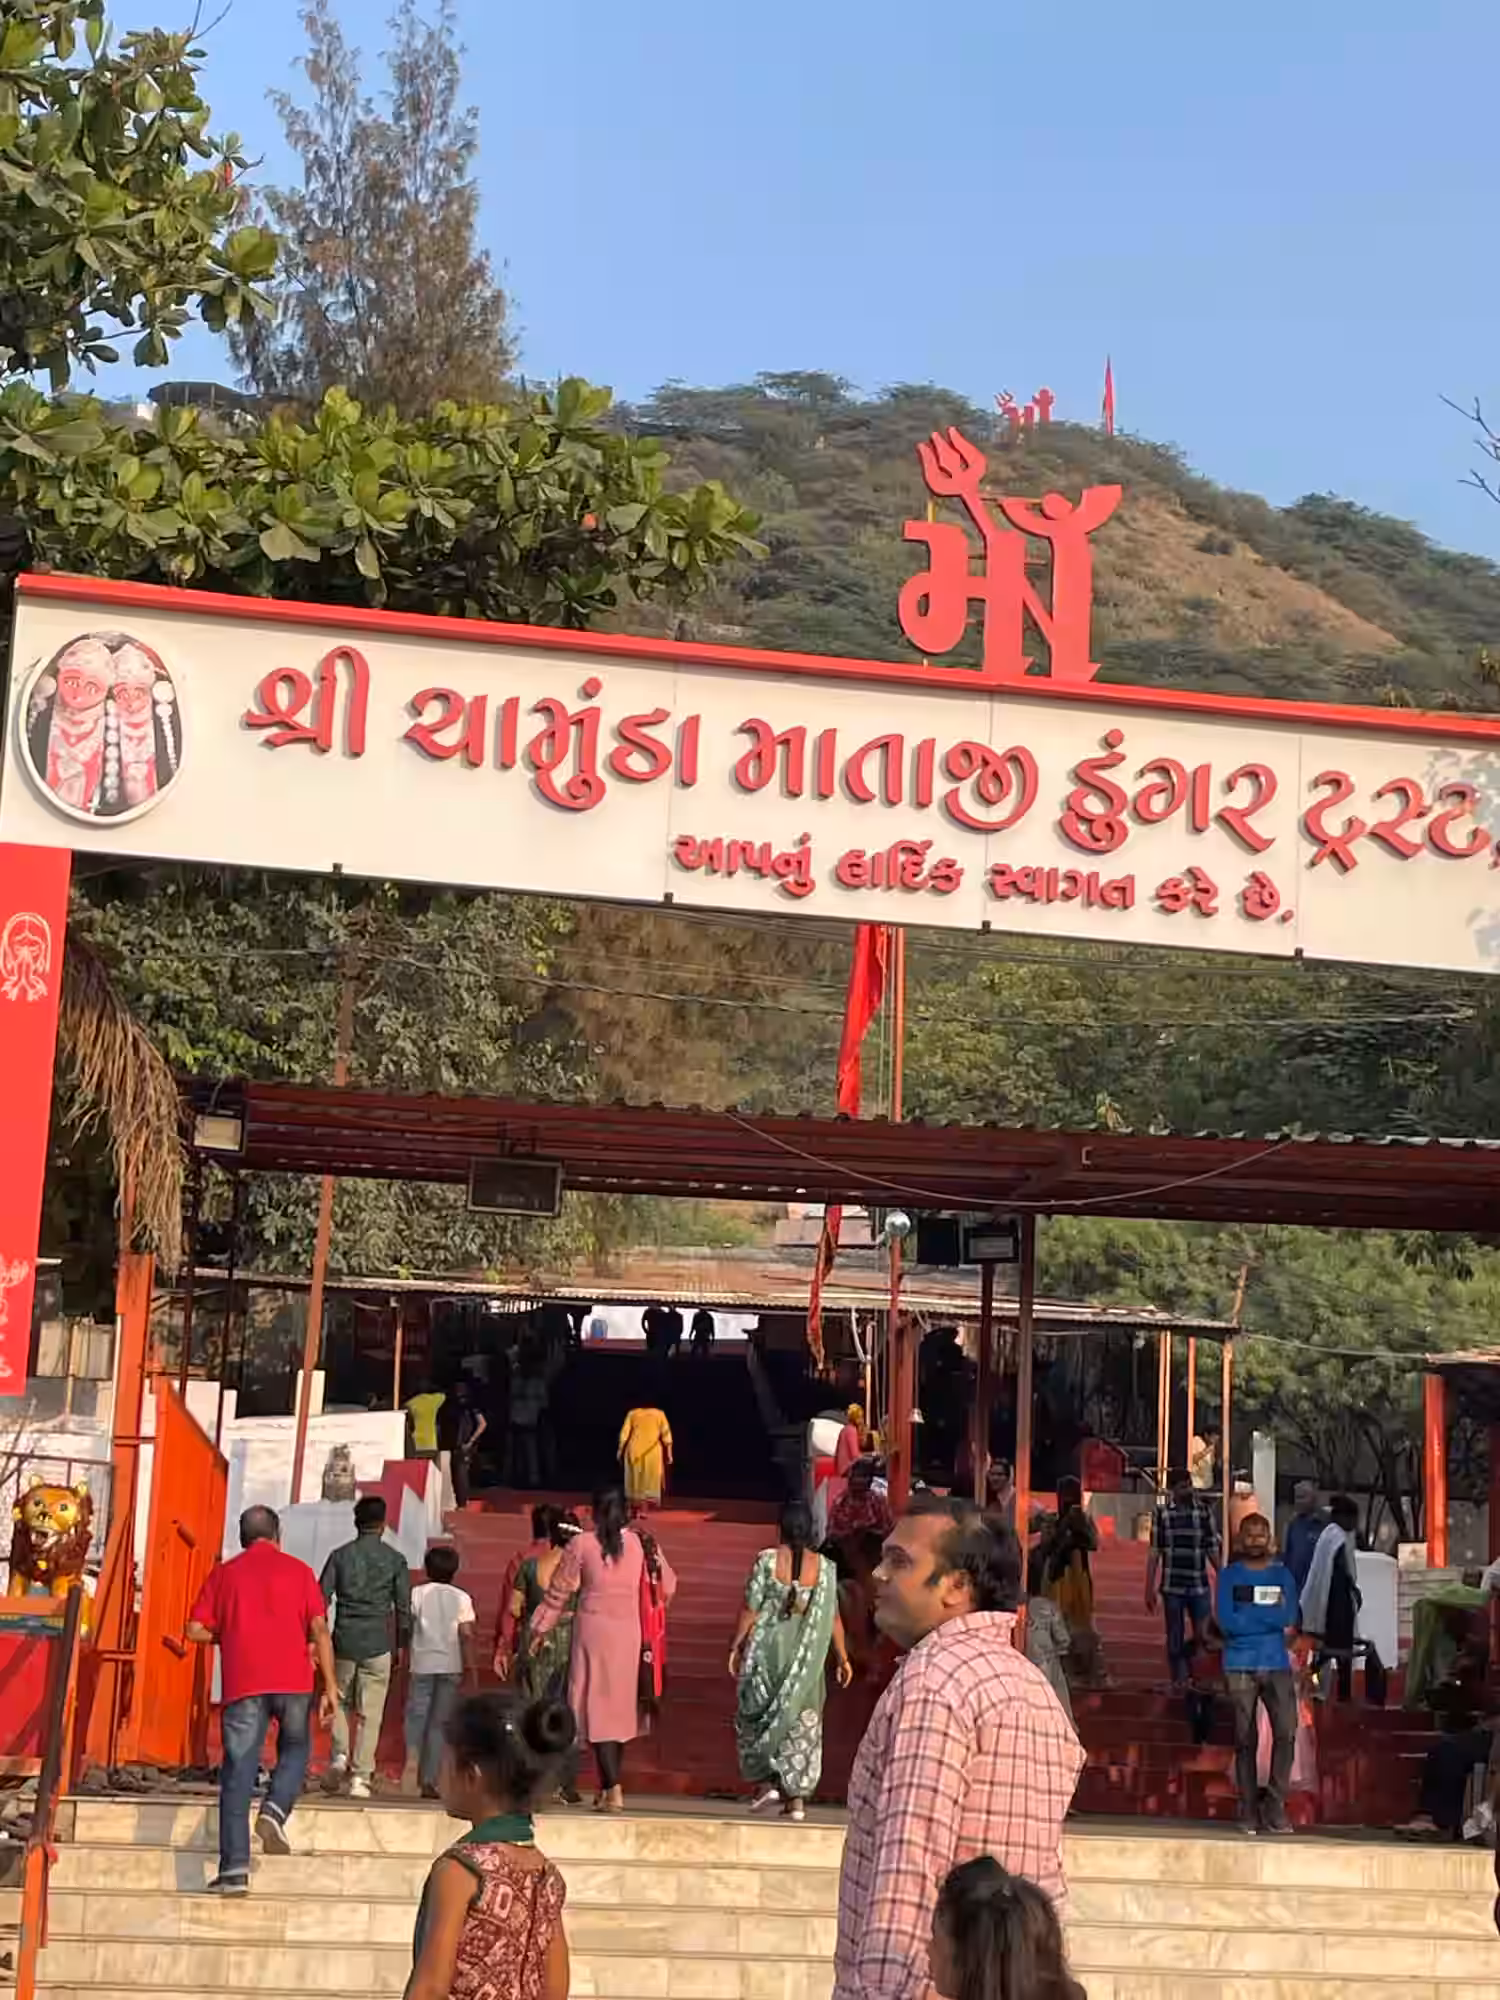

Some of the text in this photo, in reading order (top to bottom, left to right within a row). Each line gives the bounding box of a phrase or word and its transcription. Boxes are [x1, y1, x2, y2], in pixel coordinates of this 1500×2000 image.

[243, 645, 371, 757] શ્રી
[402, 676, 702, 811] ચામુંડા
[733, 717, 1039, 832] માતાજી
[1059, 728, 1279, 855] ડુંગર
[674, 831, 1295, 922] આપનું હાર્દિક સ્વાગત કરે છે.
